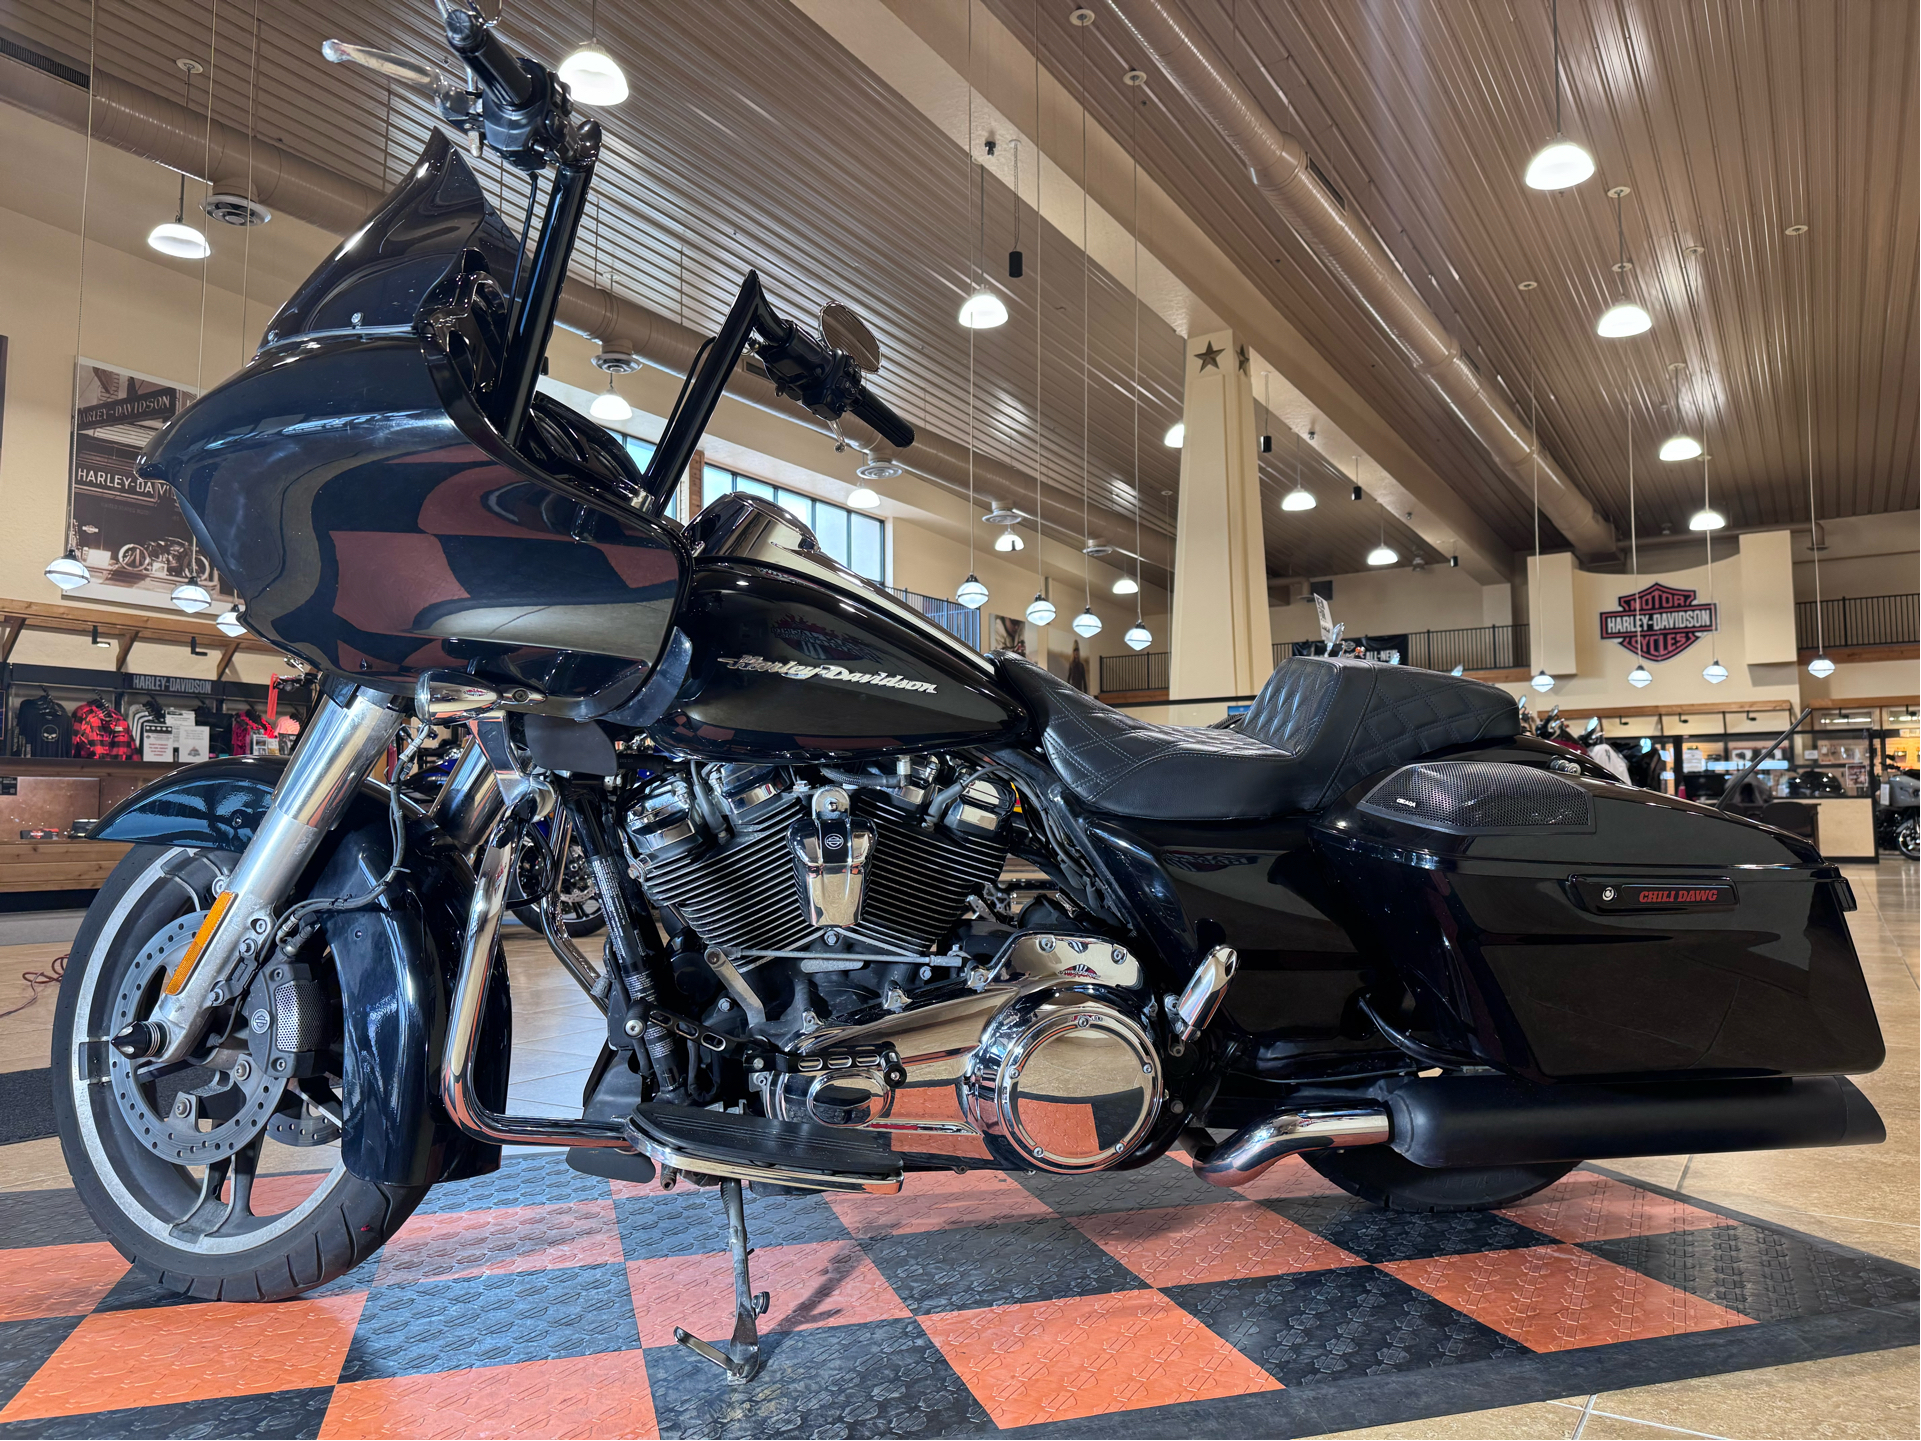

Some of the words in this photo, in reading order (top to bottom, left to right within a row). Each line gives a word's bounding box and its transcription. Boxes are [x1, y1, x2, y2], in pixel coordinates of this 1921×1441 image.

[1629, 589, 1686, 611] MOTOR
[1607, 609, 1710, 633] HARLEY-DAVIDSON
[1630, 632, 1687, 656] CYCLES
[132, 674, 212, 695] HARLEY-DAVIDSON
[717, 654, 938, 694] Harley-Davidson
[1639, 890, 1675, 903] CHILI
[1677, 889, 1718, 903] DAWG
